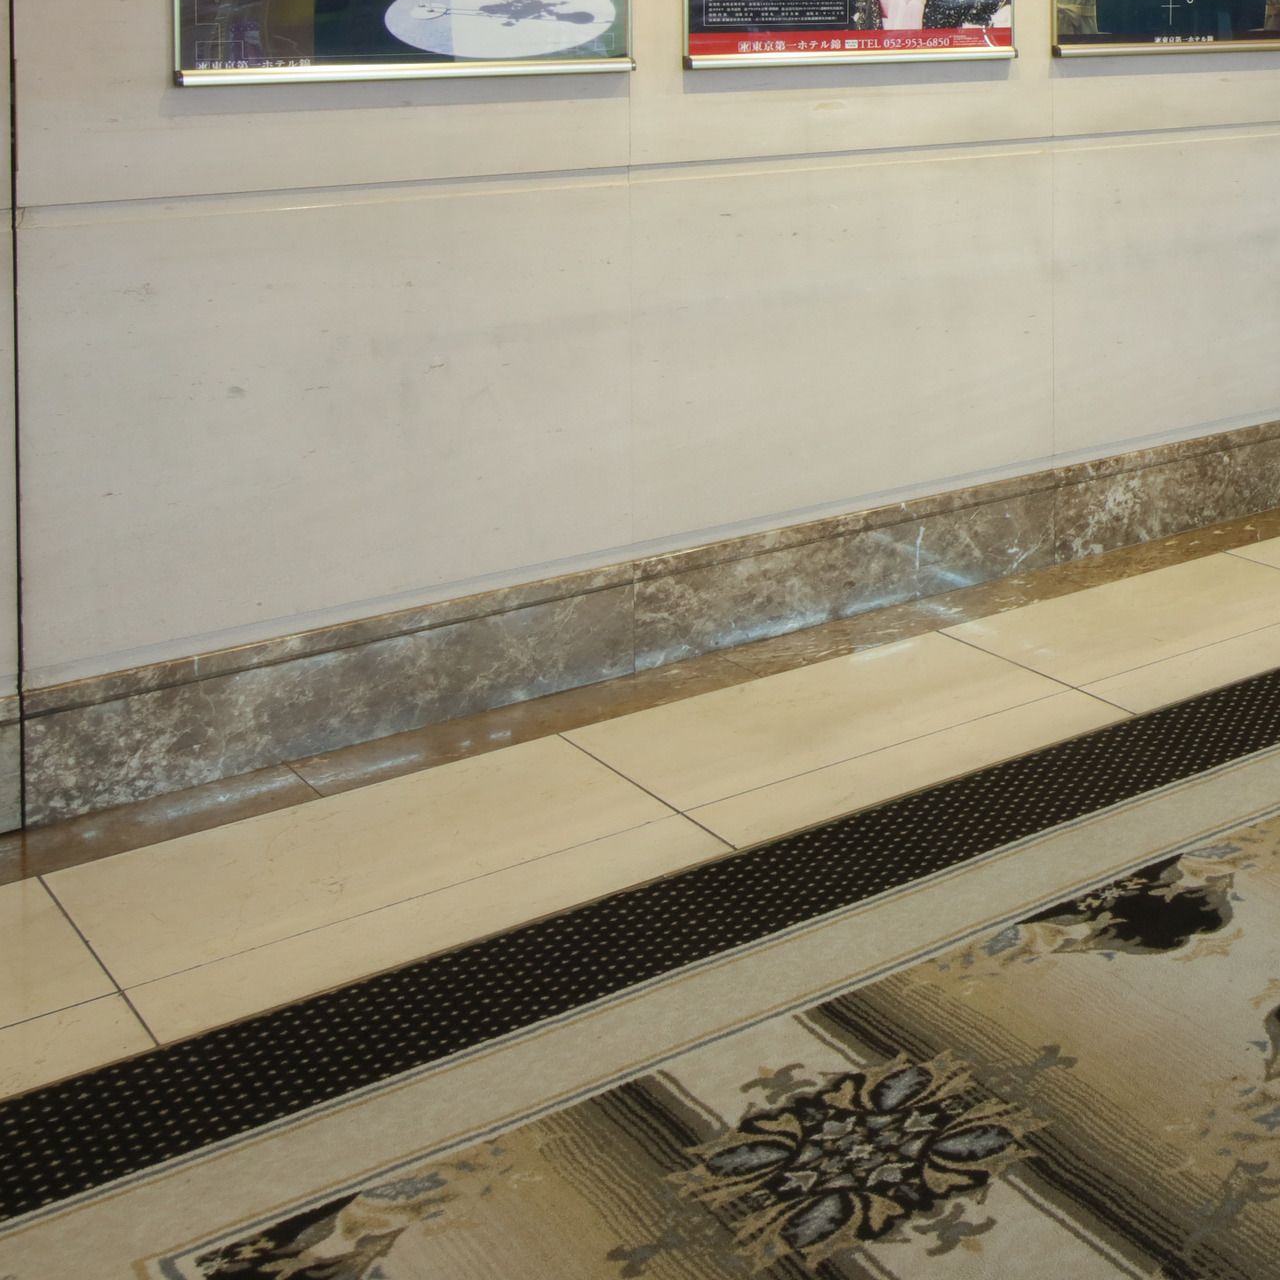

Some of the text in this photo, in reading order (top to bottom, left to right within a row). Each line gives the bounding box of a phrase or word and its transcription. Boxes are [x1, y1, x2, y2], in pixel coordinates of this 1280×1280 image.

[752, 38, 841, 51] 東京第一ホテル錦
[858, 39, 881, 49] TEL
[883, 36, 950, 49] 052-953-6850
